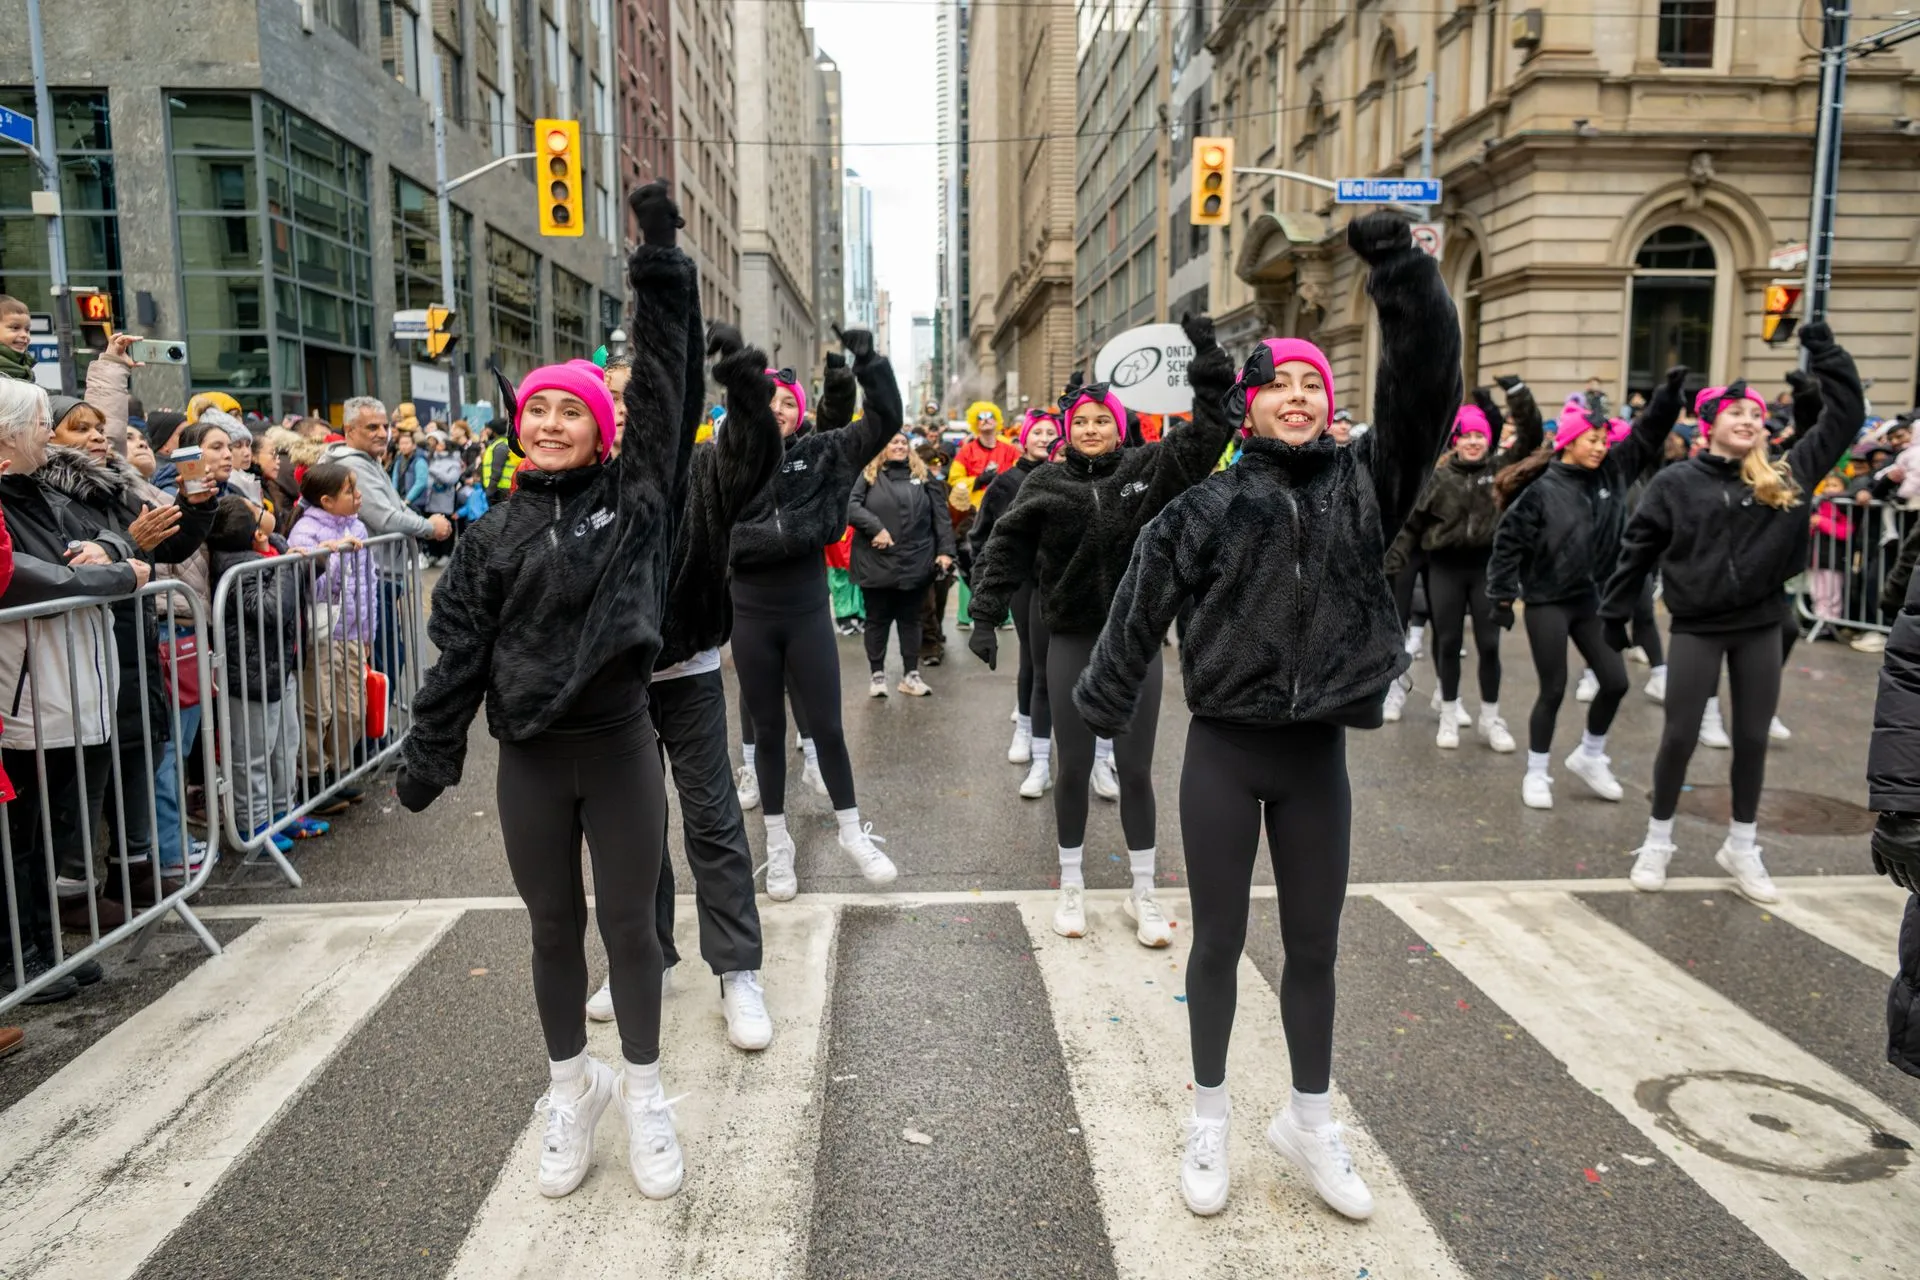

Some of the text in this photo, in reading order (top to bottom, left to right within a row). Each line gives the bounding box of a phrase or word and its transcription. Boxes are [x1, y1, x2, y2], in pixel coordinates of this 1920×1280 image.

[1341, 181, 1424, 200] Wellington
[1166, 346, 1192, 358] ONTA
[1167, 360, 1189, 373] SCH
[1167, 375, 1180, 387] OF
